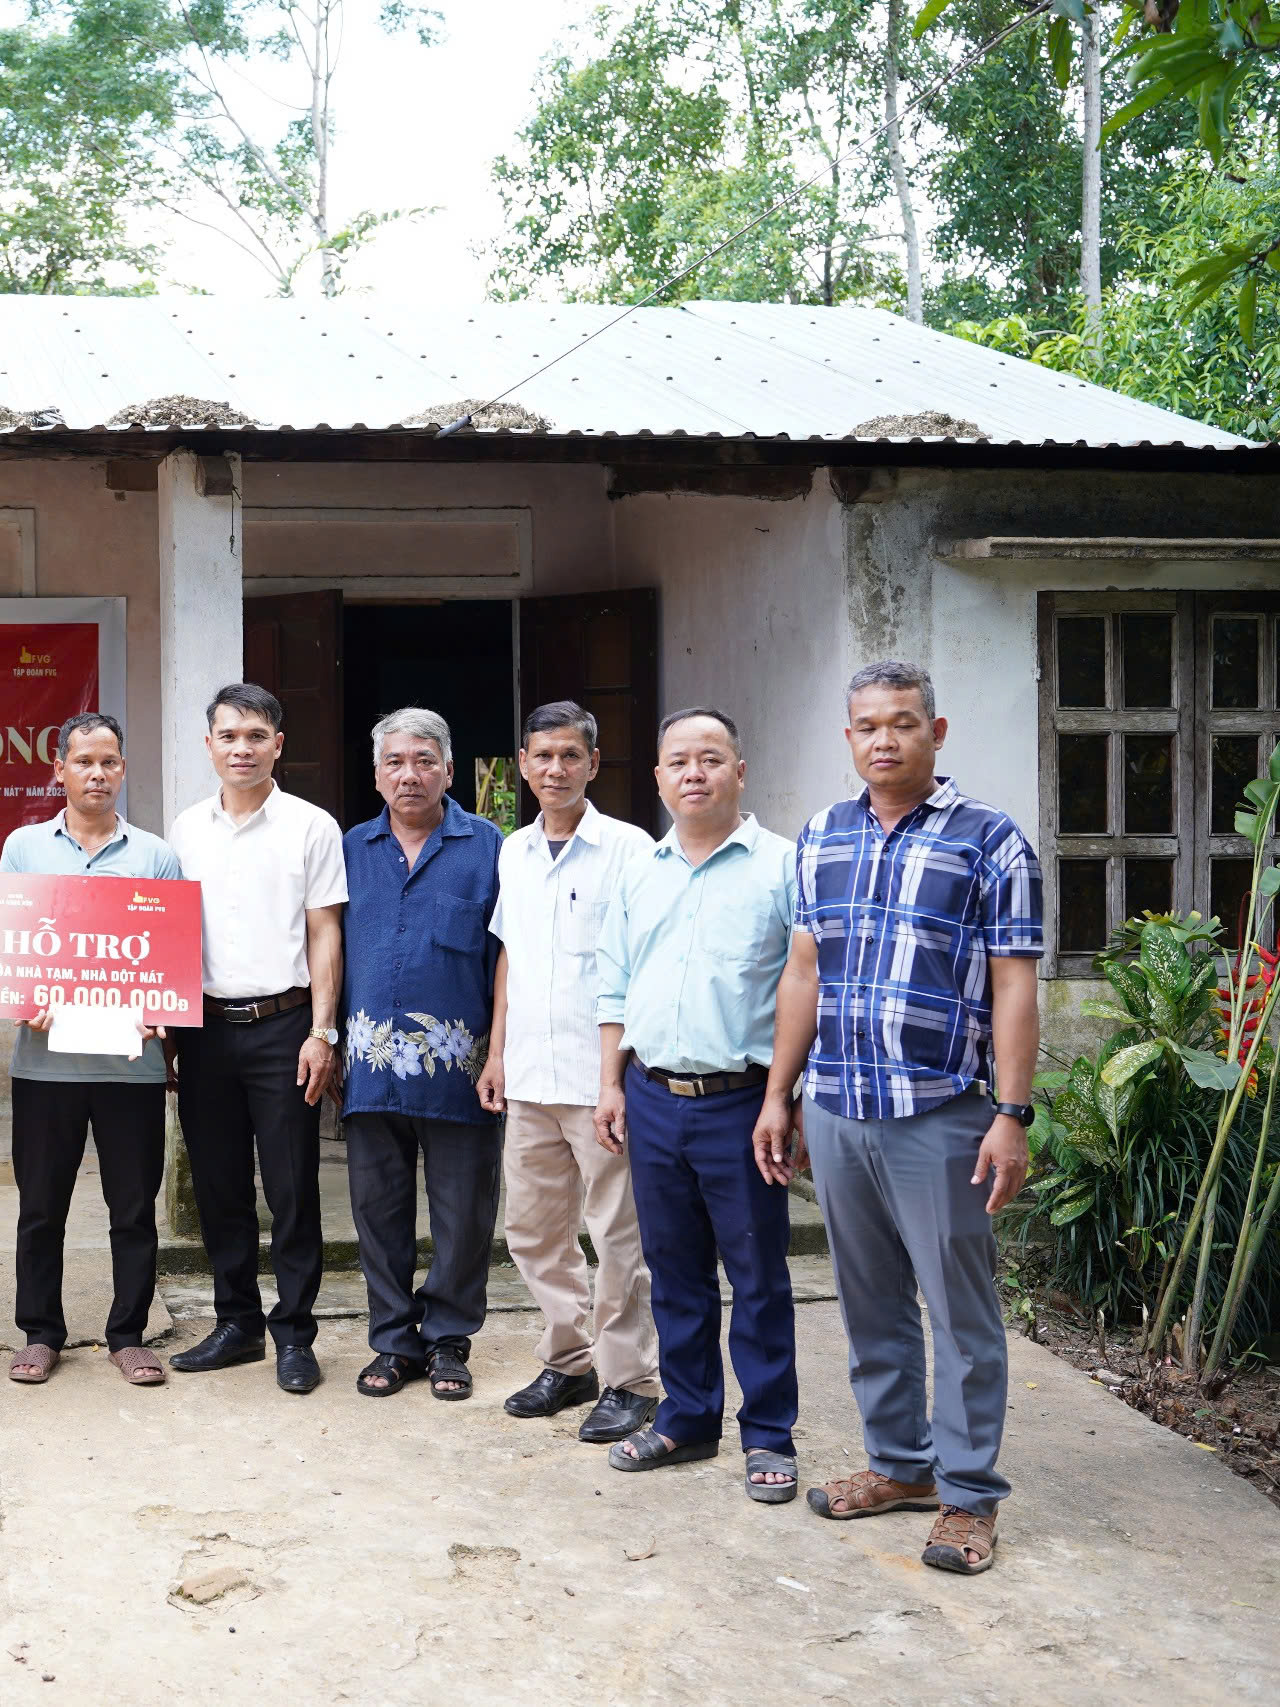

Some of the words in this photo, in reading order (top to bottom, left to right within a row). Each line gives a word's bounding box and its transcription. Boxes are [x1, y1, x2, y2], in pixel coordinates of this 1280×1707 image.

[32, 655, 51, 663] FVG
[44, 668, 57, 676] FVG
[26, 785, 44, 797] NĂM
[46, 787, 67, 797] 2025
[2, 917, 62, 956] HỖ
[69, 931, 150, 965] TRỢ
[16, 964, 42, 979] NHÀ
[46, 967, 78, 982] TẠM,
[81, 967, 107, 981] NHÀ
[111, 967, 136, 984] DỘT
[140, 968, 164, 984] NÁT
